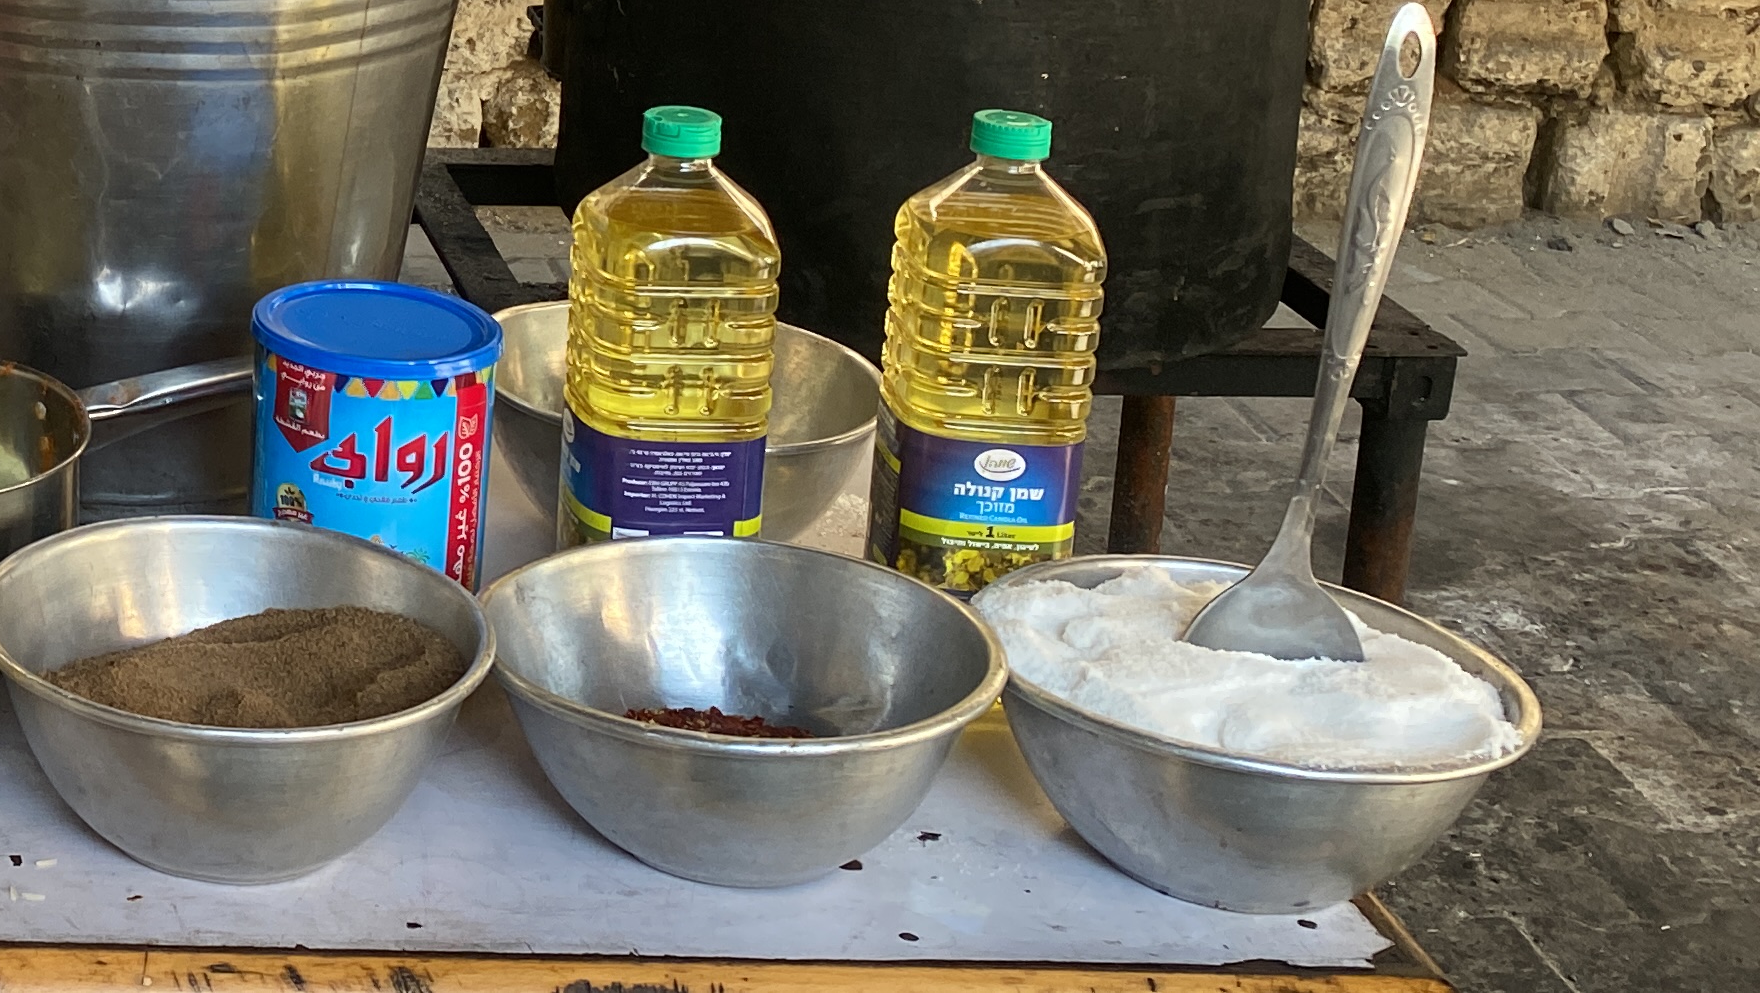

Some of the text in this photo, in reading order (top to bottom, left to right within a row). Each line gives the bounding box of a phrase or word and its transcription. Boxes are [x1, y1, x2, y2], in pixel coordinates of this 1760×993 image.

[310, 415, 449, 494] روابي
[953, 481, 1045, 502] שמן קנולה
[976, 501, 1015, 515] מזוכך
[985, 526, 995, 538] 1
